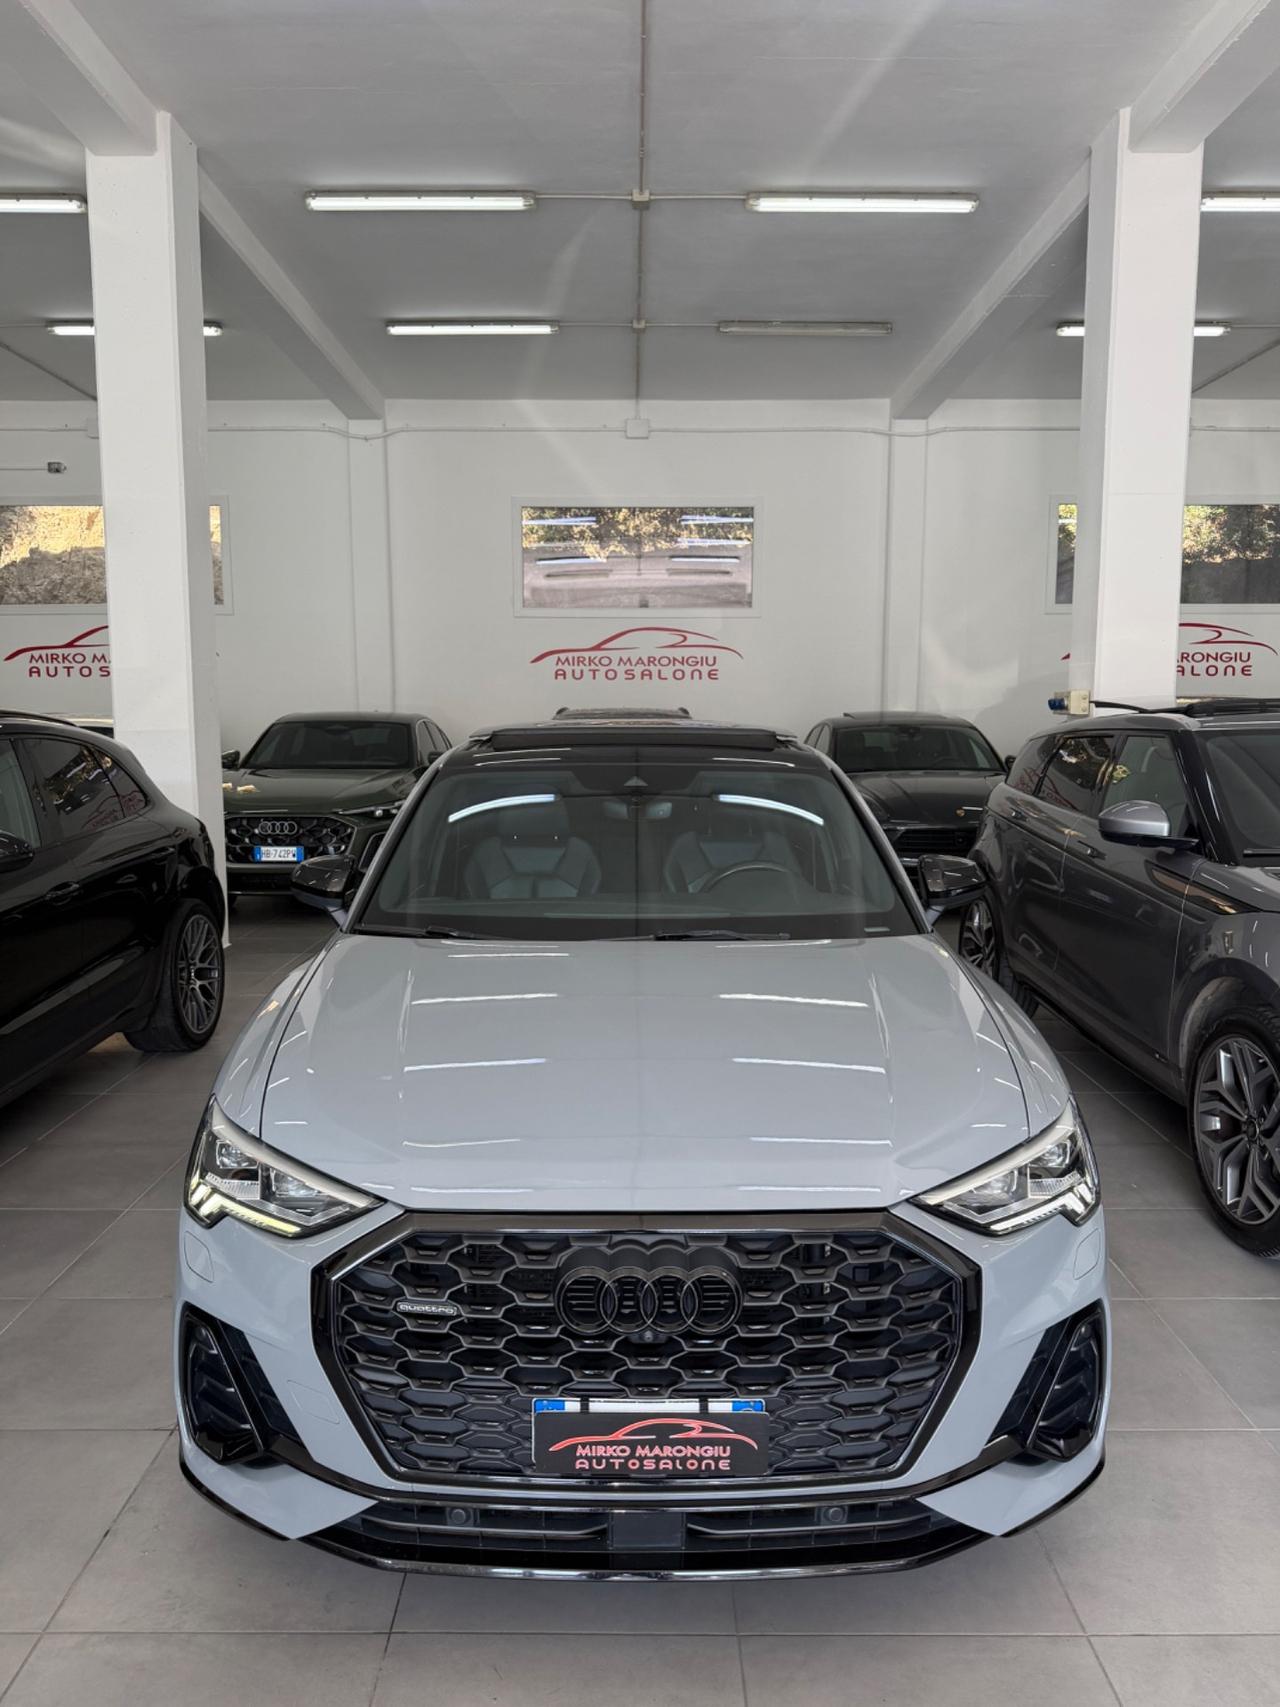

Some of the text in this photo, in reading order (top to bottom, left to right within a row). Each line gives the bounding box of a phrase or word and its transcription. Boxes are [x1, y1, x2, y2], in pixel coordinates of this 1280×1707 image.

[29, 653, 86, 664] MIRKO
[555, 655, 717, 667] MIRKO MARONGIU
[1177, 651, 1251, 663] RONGIU
[554, 668, 719, 681] AUTOSALONE
[399, 1303, 455, 1314] quattro
[576, 1445, 731, 1457] MIRKO MARONGIU
[575, 1458, 731, 1470] AUTOSALONE
